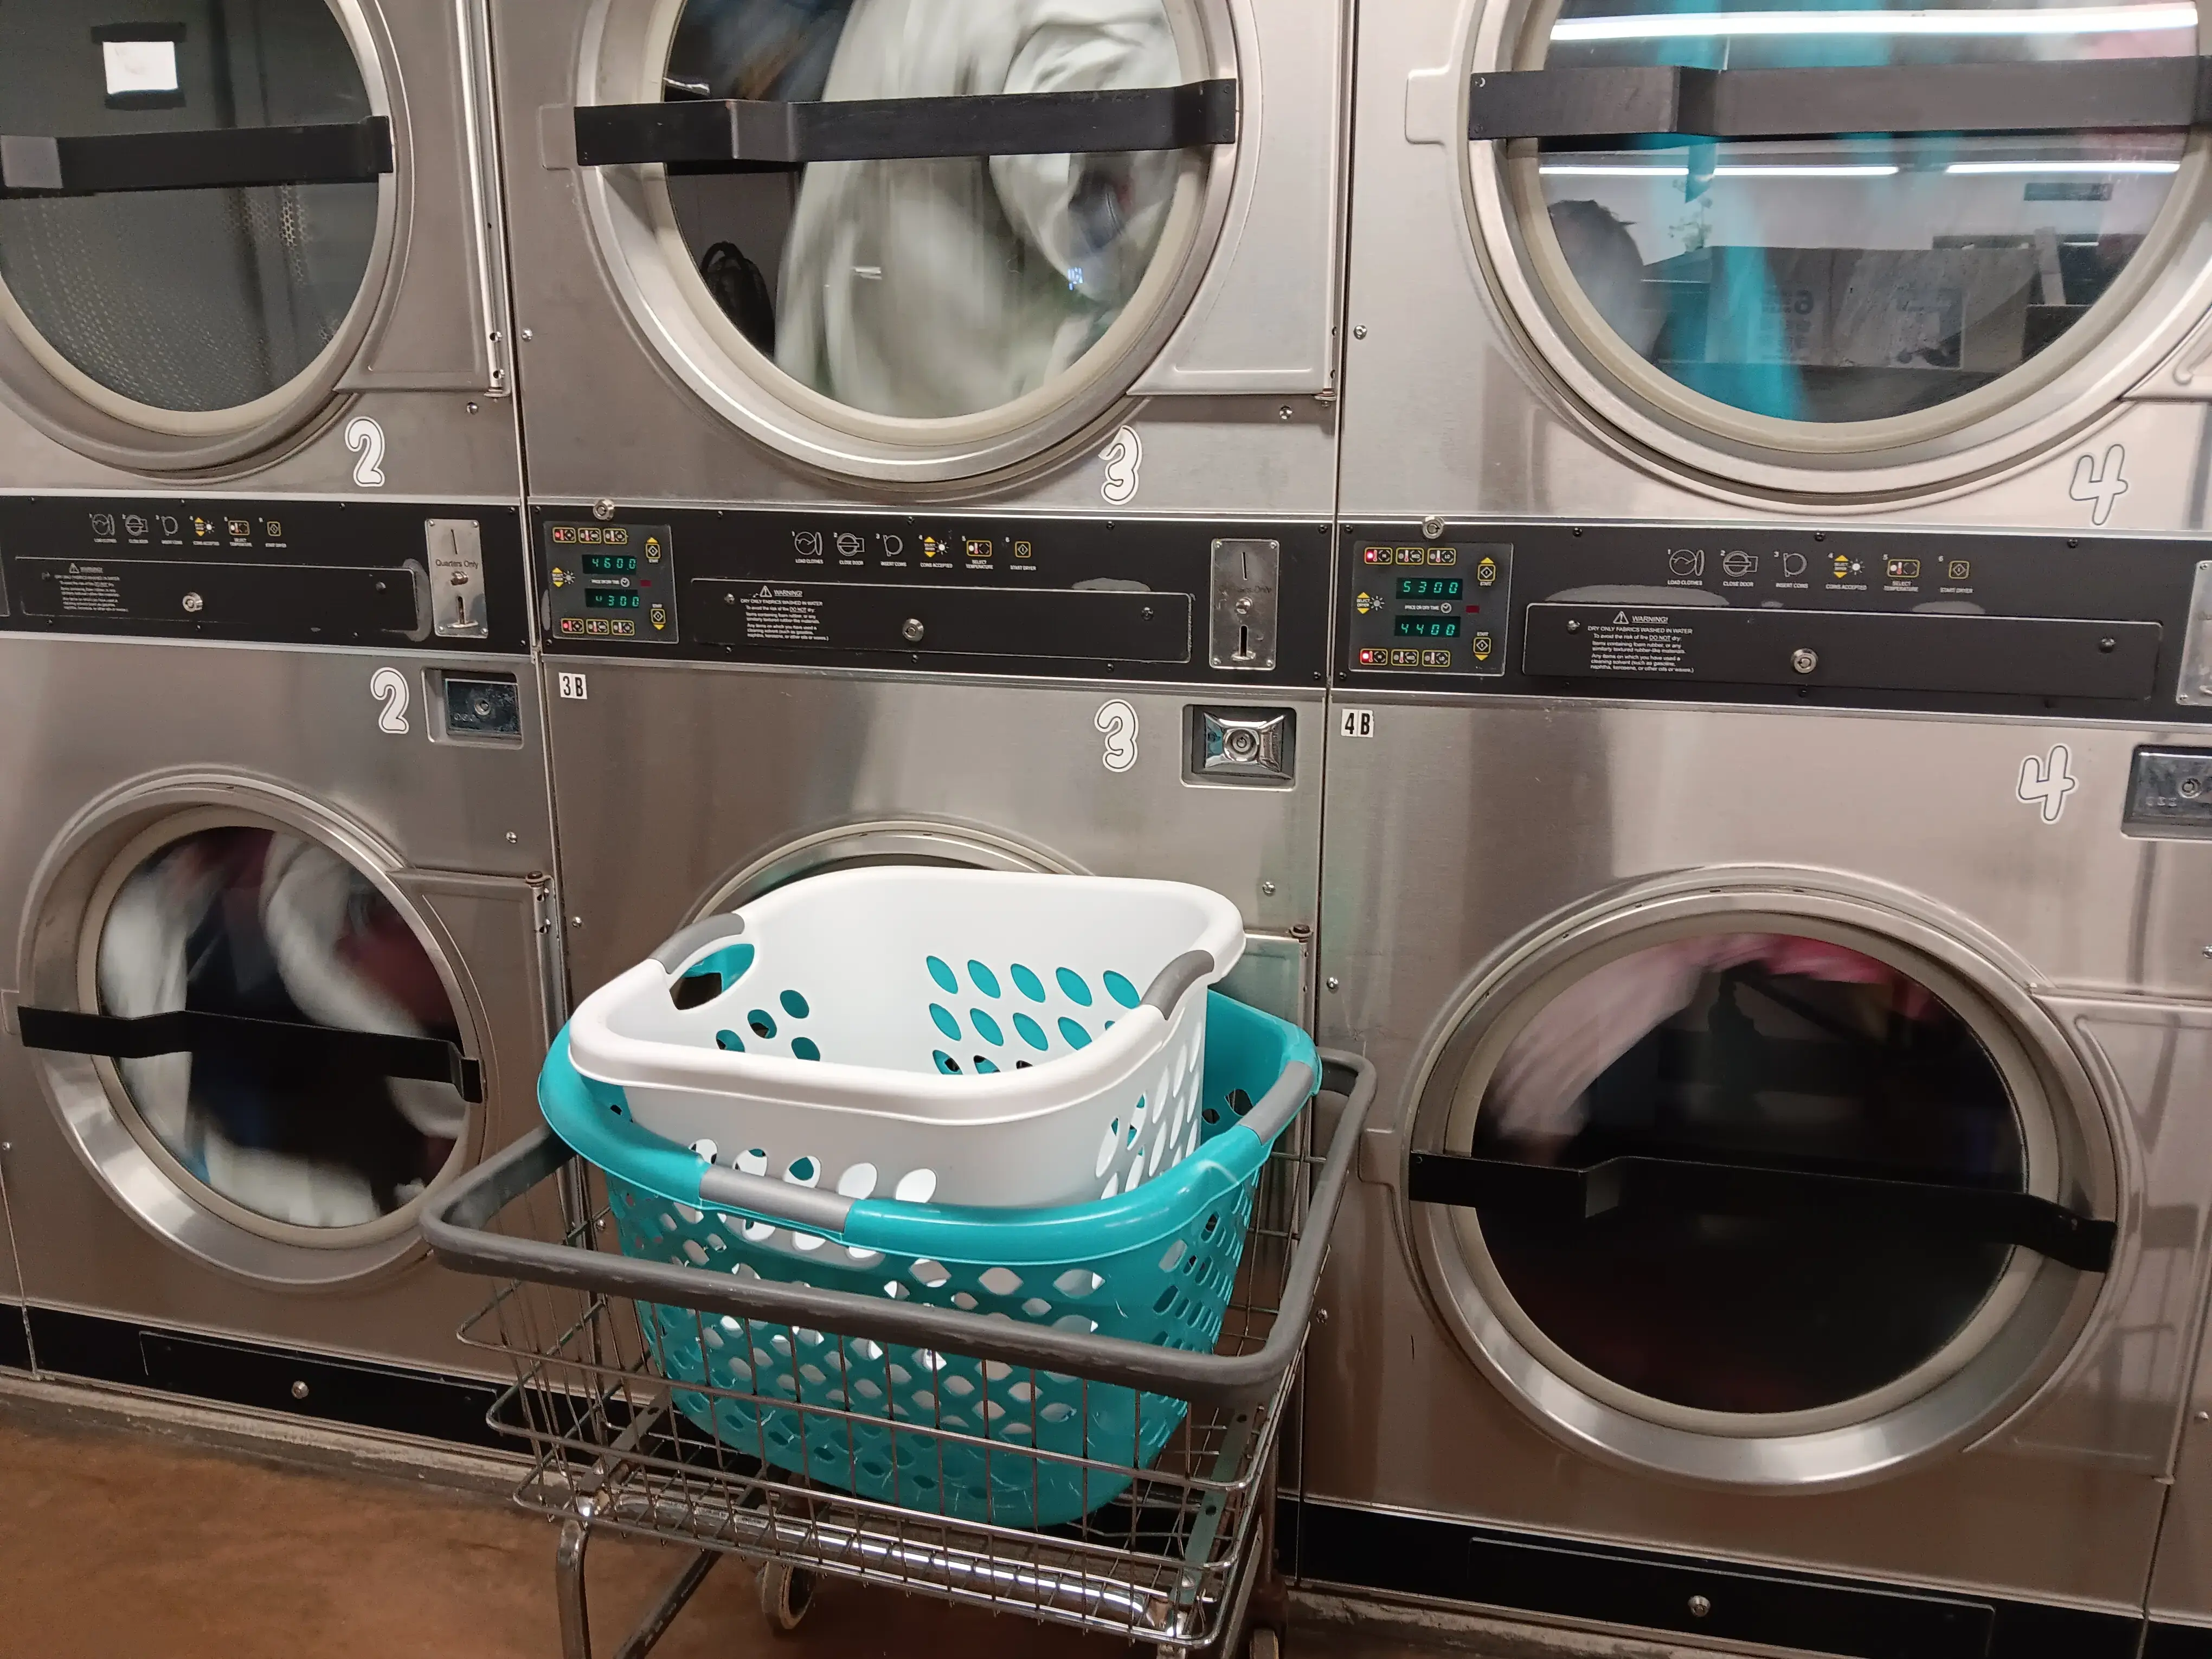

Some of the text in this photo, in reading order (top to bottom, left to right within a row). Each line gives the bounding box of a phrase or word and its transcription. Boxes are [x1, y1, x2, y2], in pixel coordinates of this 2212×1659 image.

[345, 416, 385, 487] 2
[1098, 425, 1142, 505] 3
[2069, 443, 2129, 527] 4
[435, 558, 478, 569] Quarters Only
[1403, 581, 1458, 594] 5300
[1401, 623, 1455, 636] 4400
[1631, 615, 1669, 624] WARNING!
[370, 667, 409, 734] 2
[562, 676, 584, 697] 3B
[1094, 699, 1139, 772] 3
[1344, 712, 1371, 735] 4B
[2016, 743, 2079, 825] 4
